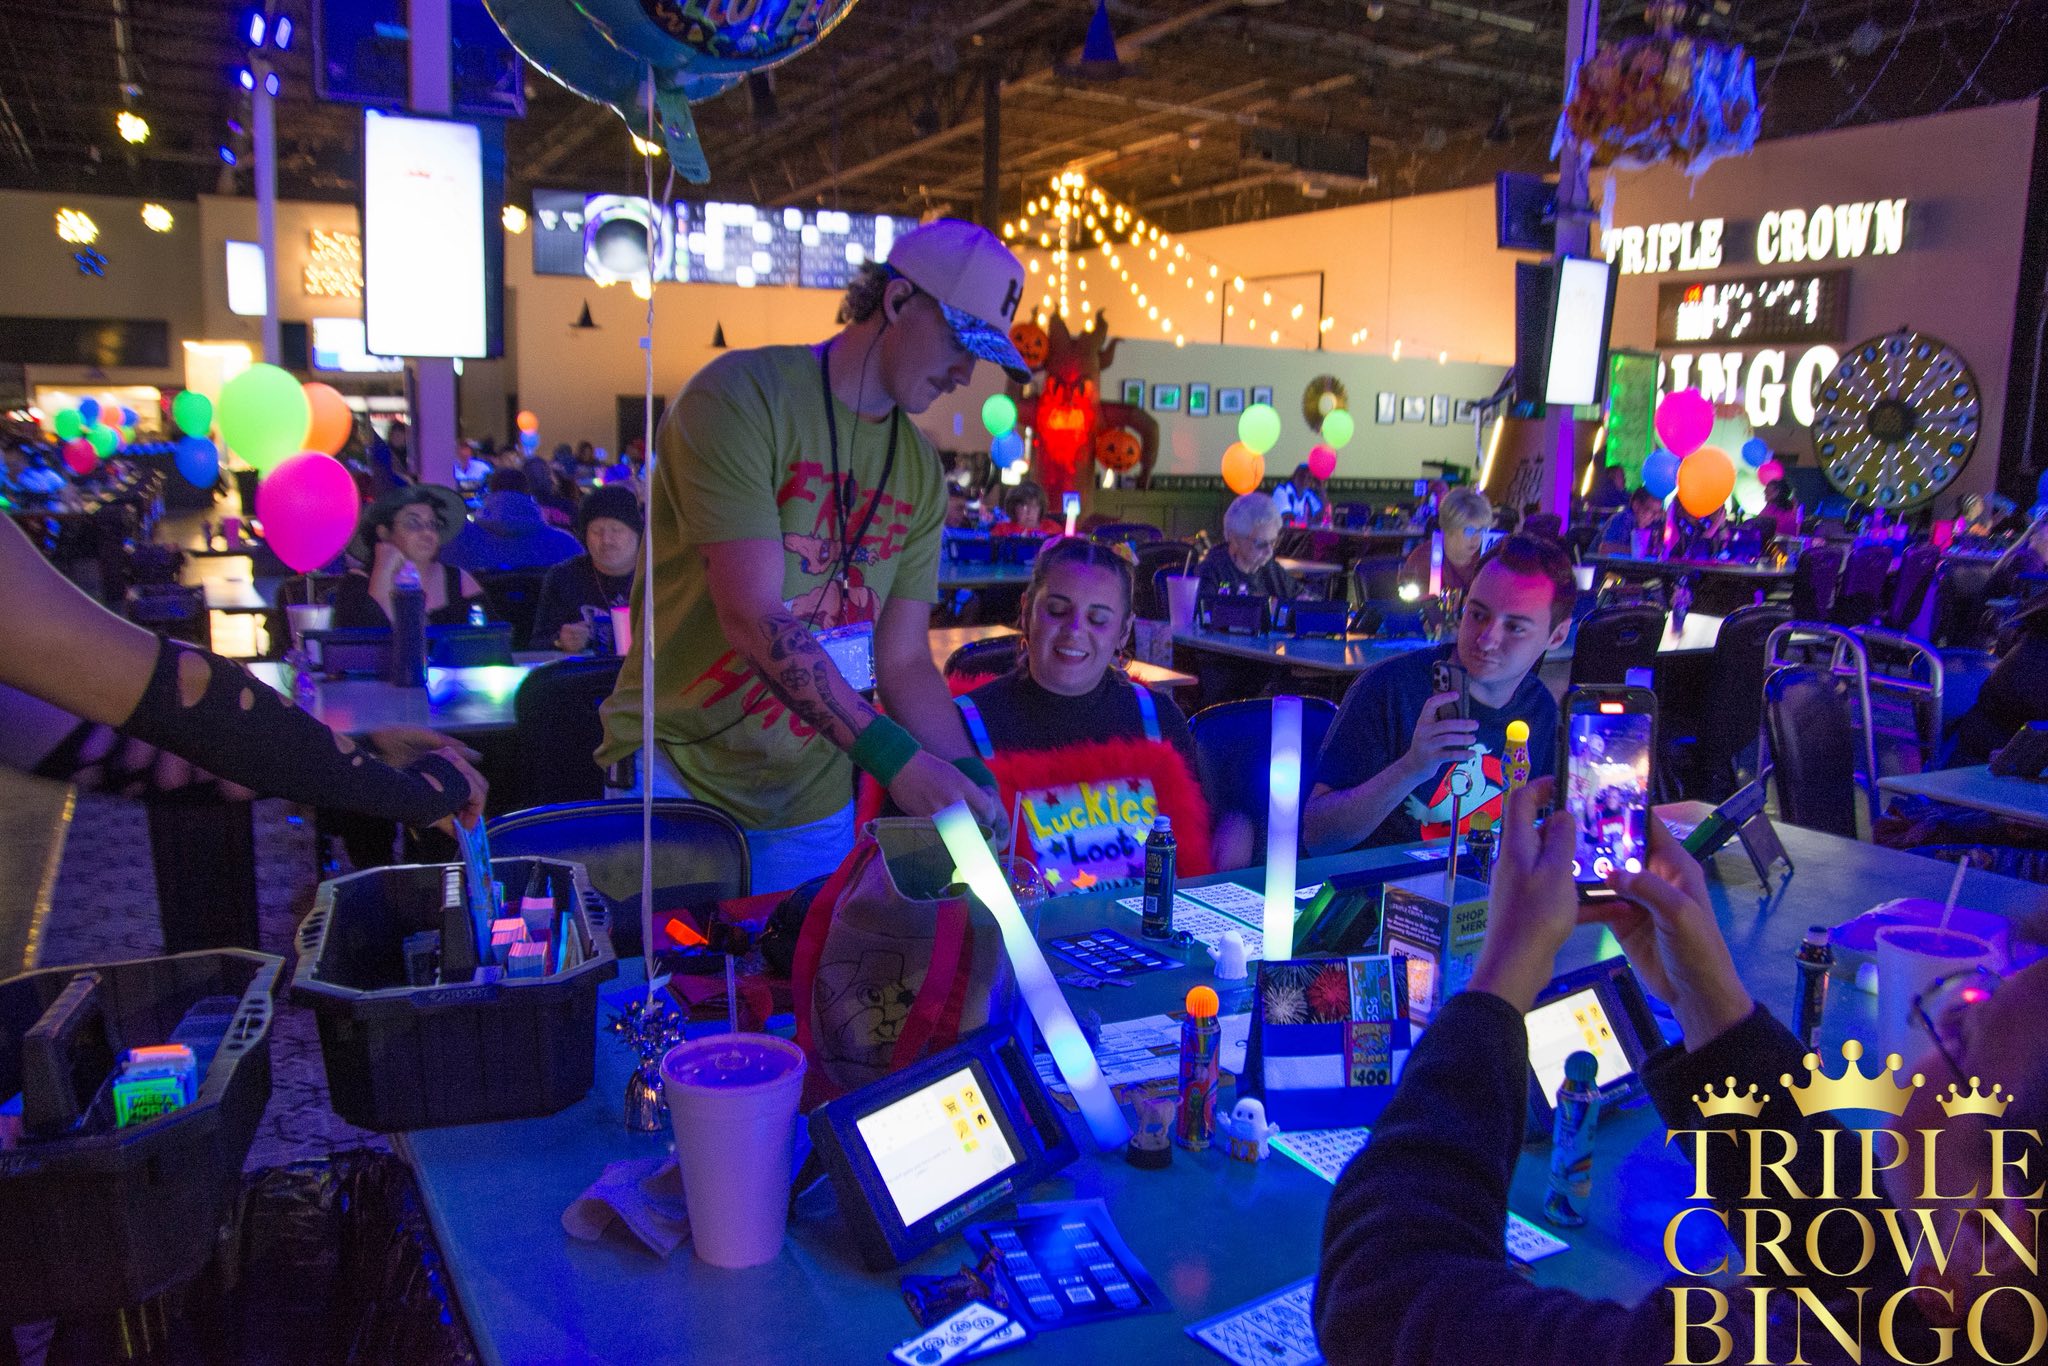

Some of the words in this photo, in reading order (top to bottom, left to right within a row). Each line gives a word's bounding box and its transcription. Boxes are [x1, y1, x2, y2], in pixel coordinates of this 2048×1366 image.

[1601, 218, 1724, 275] TRIPLE
[1756, 198, 1907, 266] CROWN
[1656, 344, 1841, 428] INGO
[1021, 781, 1161, 840] Luckies
[1064, 828, 1135, 866] Loot
[1456, 908, 1485, 924] SHOP
